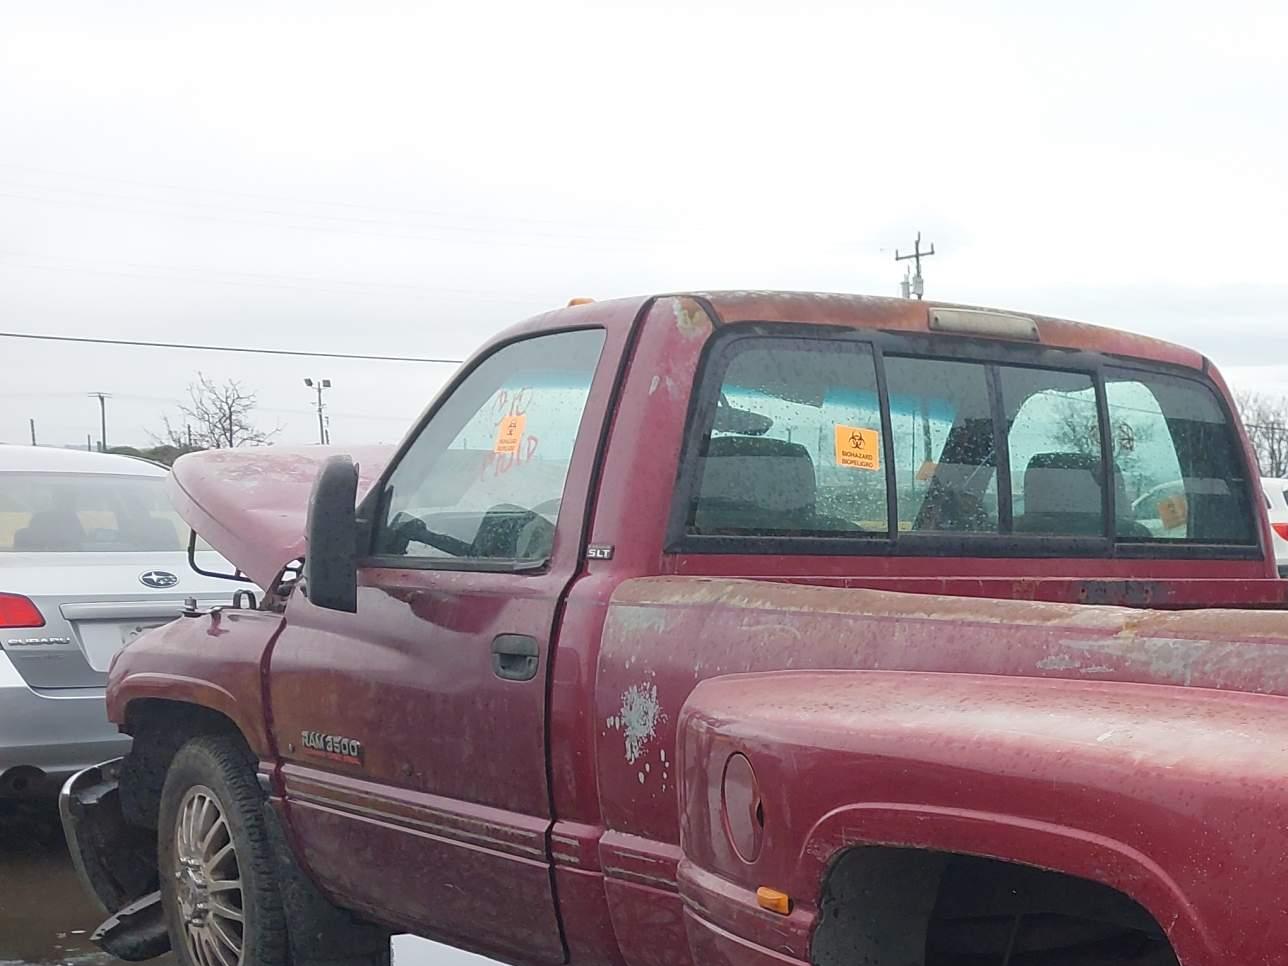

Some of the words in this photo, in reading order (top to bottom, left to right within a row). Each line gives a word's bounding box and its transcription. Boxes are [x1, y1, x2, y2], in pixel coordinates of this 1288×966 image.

[587, 548, 611, 559] SLT
[302, 730, 326, 750] RAM
[325, 735, 361, 757] 3500
